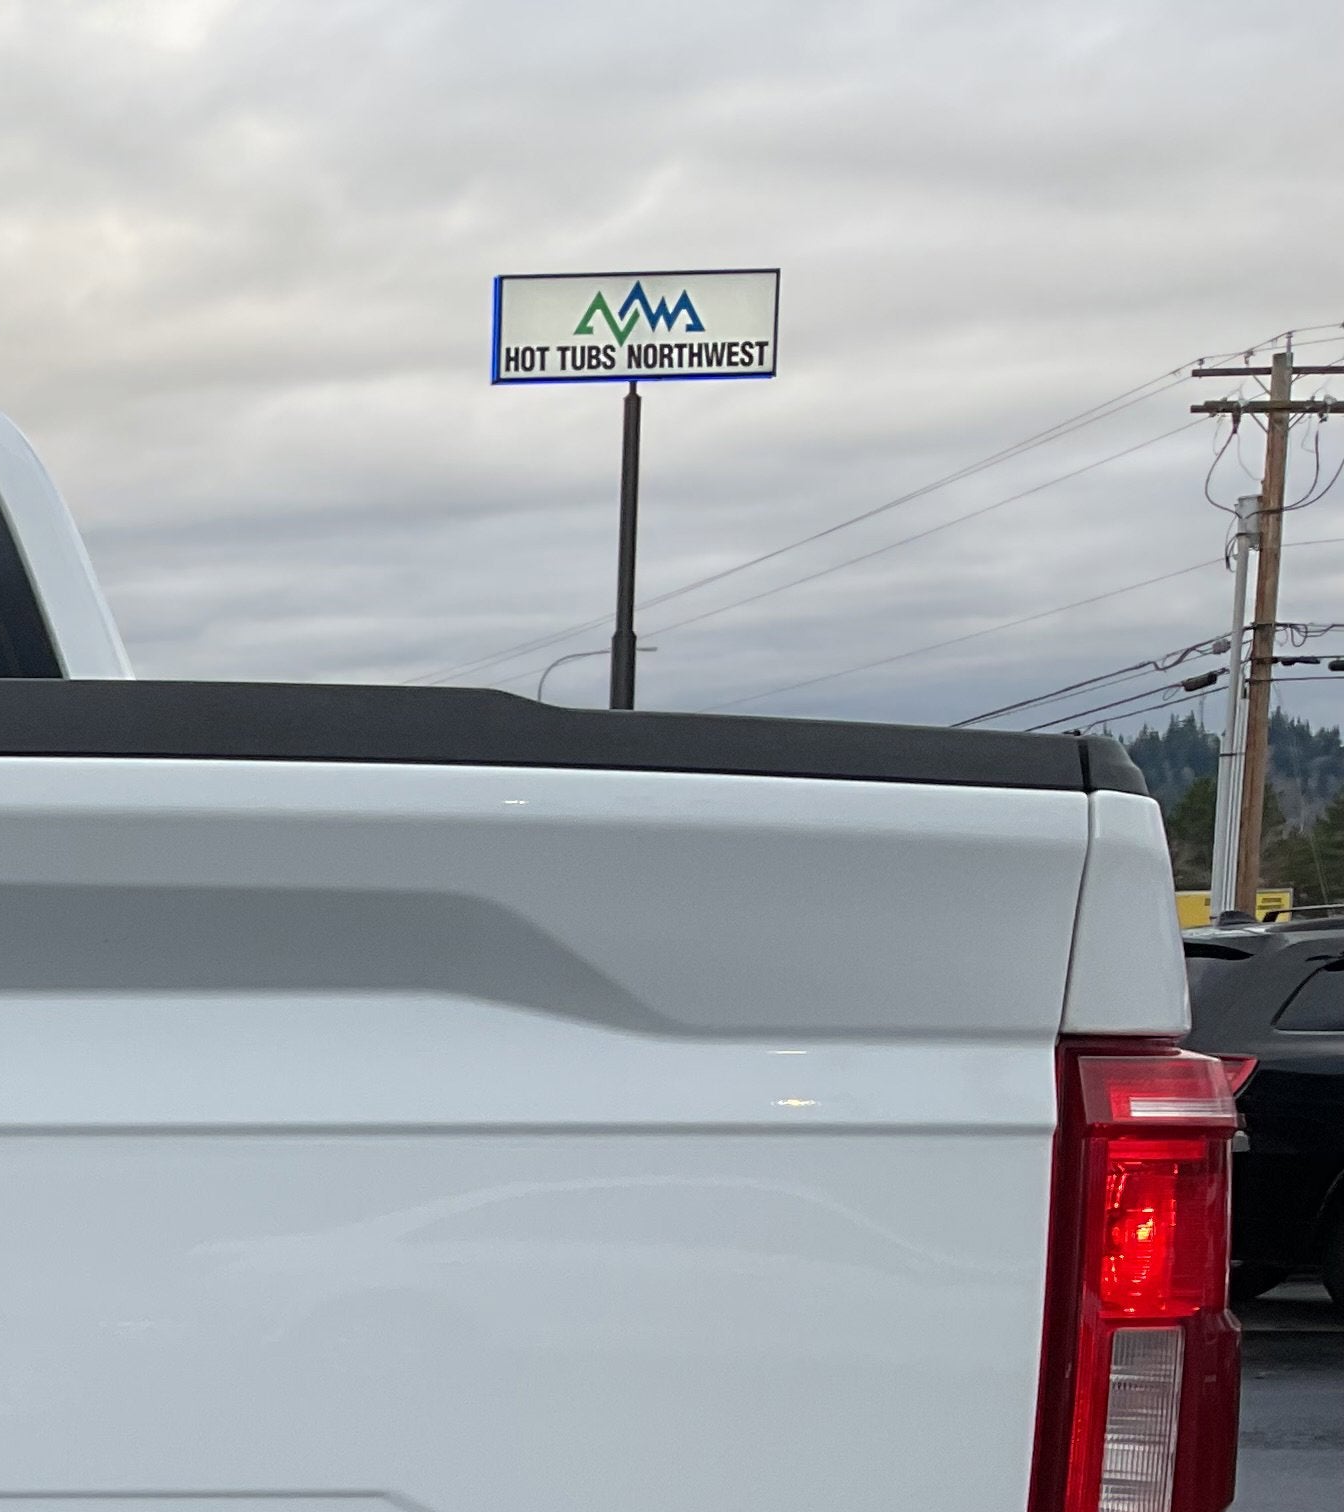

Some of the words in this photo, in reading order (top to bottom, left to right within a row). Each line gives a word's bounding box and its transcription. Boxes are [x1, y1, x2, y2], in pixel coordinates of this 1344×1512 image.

[505, 346, 549, 372] HOT
[556, 344, 616, 370] TUBS
[627, 340, 769, 369] NORTHWEST
